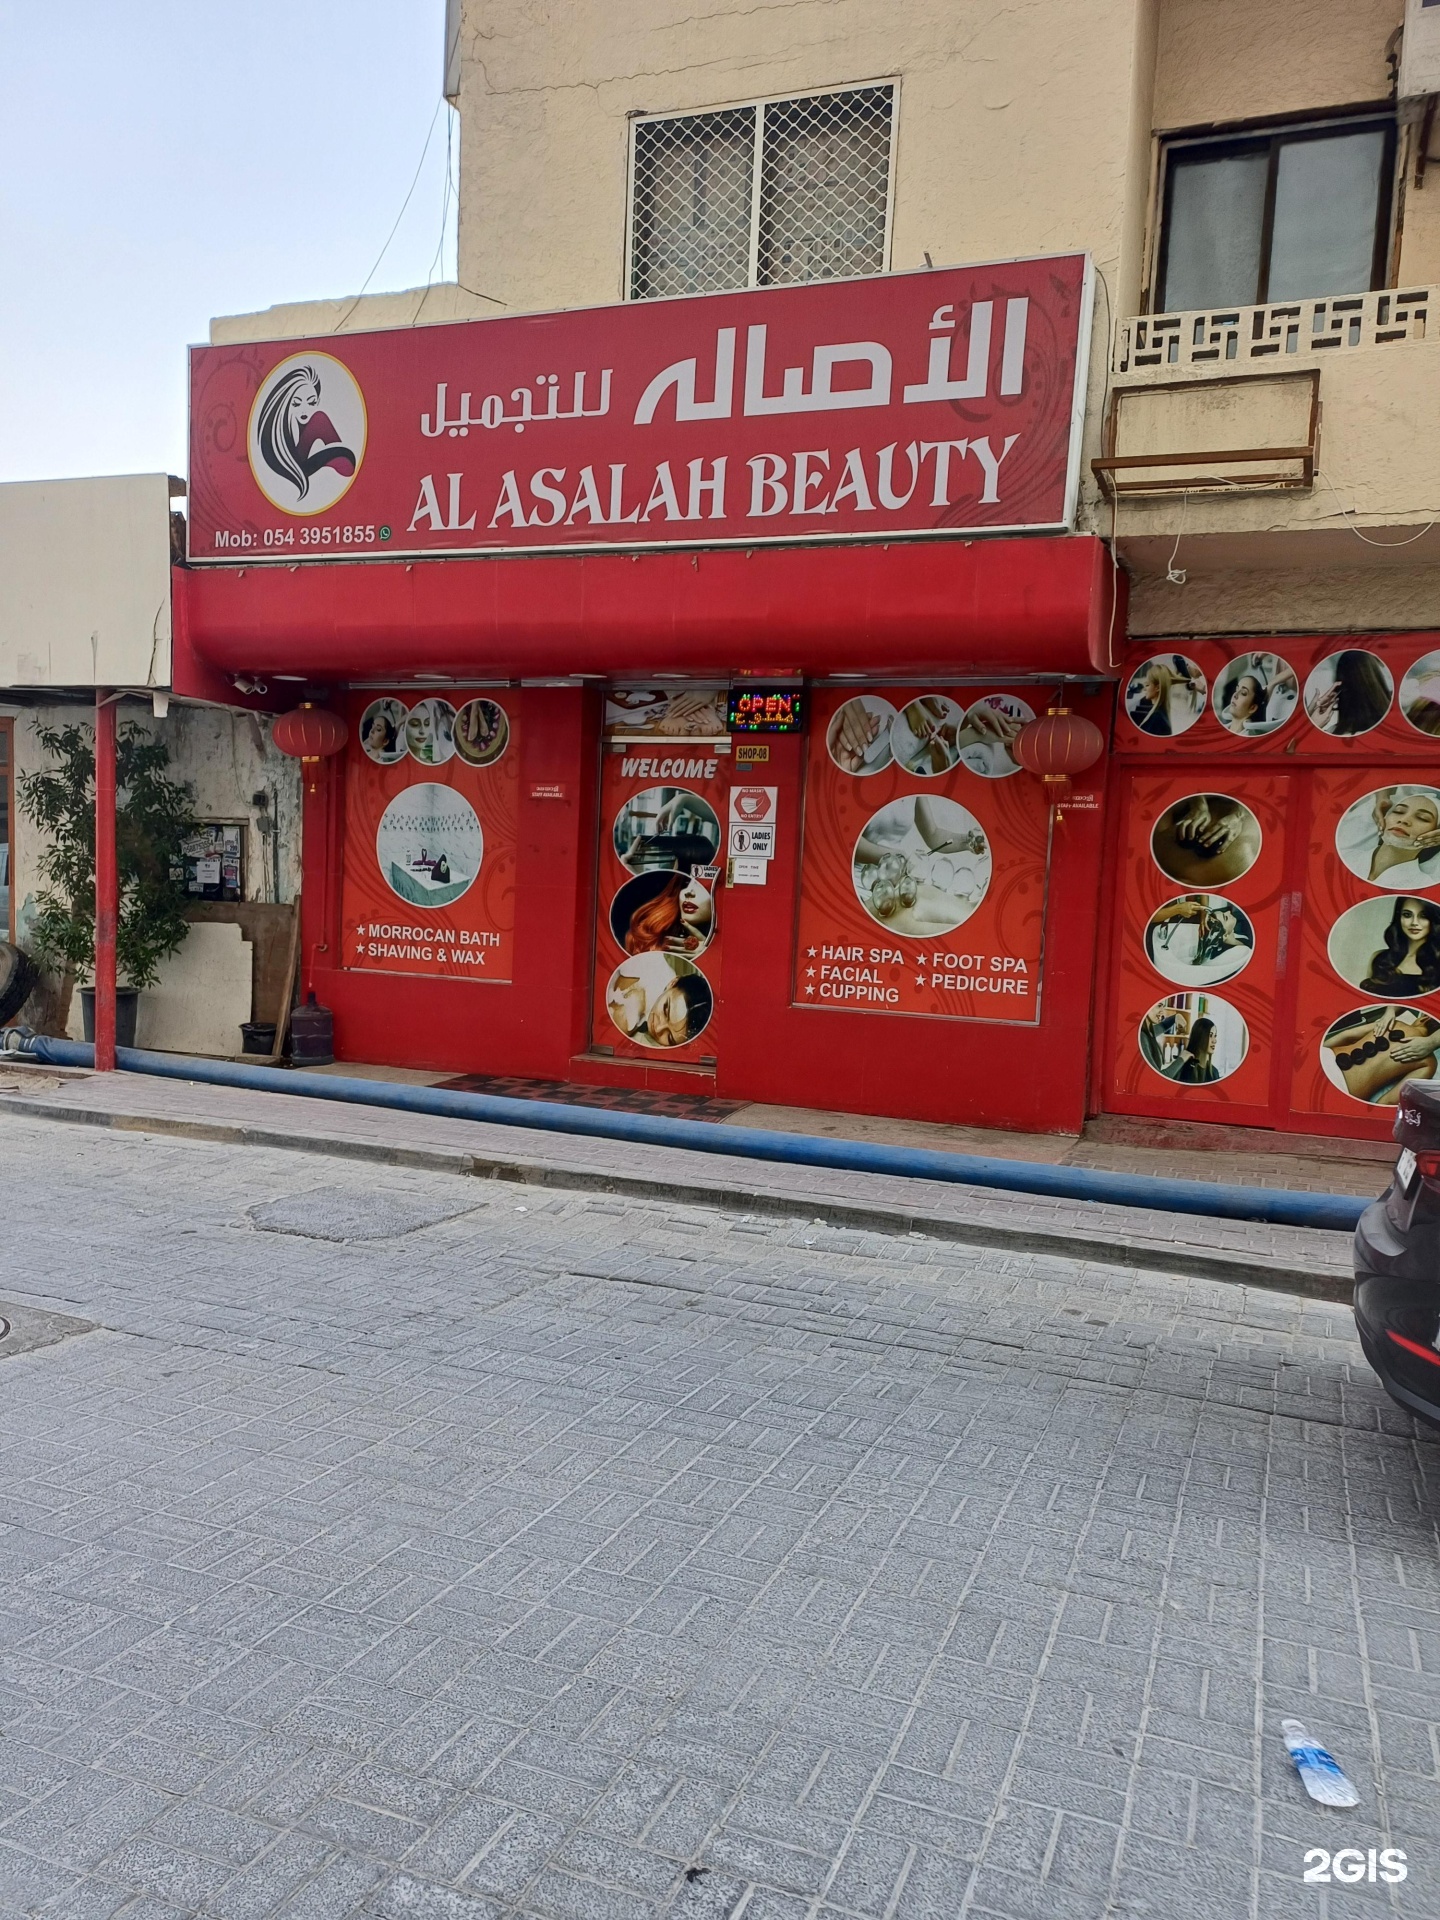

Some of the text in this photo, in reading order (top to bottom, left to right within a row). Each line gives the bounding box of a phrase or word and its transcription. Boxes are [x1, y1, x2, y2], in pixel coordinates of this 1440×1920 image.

[420, 367, 614, 438] للتجميل
[406, 432, 1022, 532] AL ASALAH BEAUTY
[214, 525, 376, 549] Mob: 054 3951855
[739, 697, 791, 712] OPEN
[738, 747, 767, 759] SHOP-08
[621, 758, 719, 779] WELCOME
[751, 831, 771, 840] LADIES
[752, 842, 768, 851] ONLY
[368, 924, 501, 948] MORROCAN BATH
[367, 943, 486, 966] SHAVING & WAX
[821, 945, 905, 965] HAIR SPA
[932, 952, 1028, 974] FOOT SPA
[820, 966, 883, 984] FACIAL
[931, 973, 1029, 995] PEDICURE
[818, 983, 900, 1003] CUPPING
